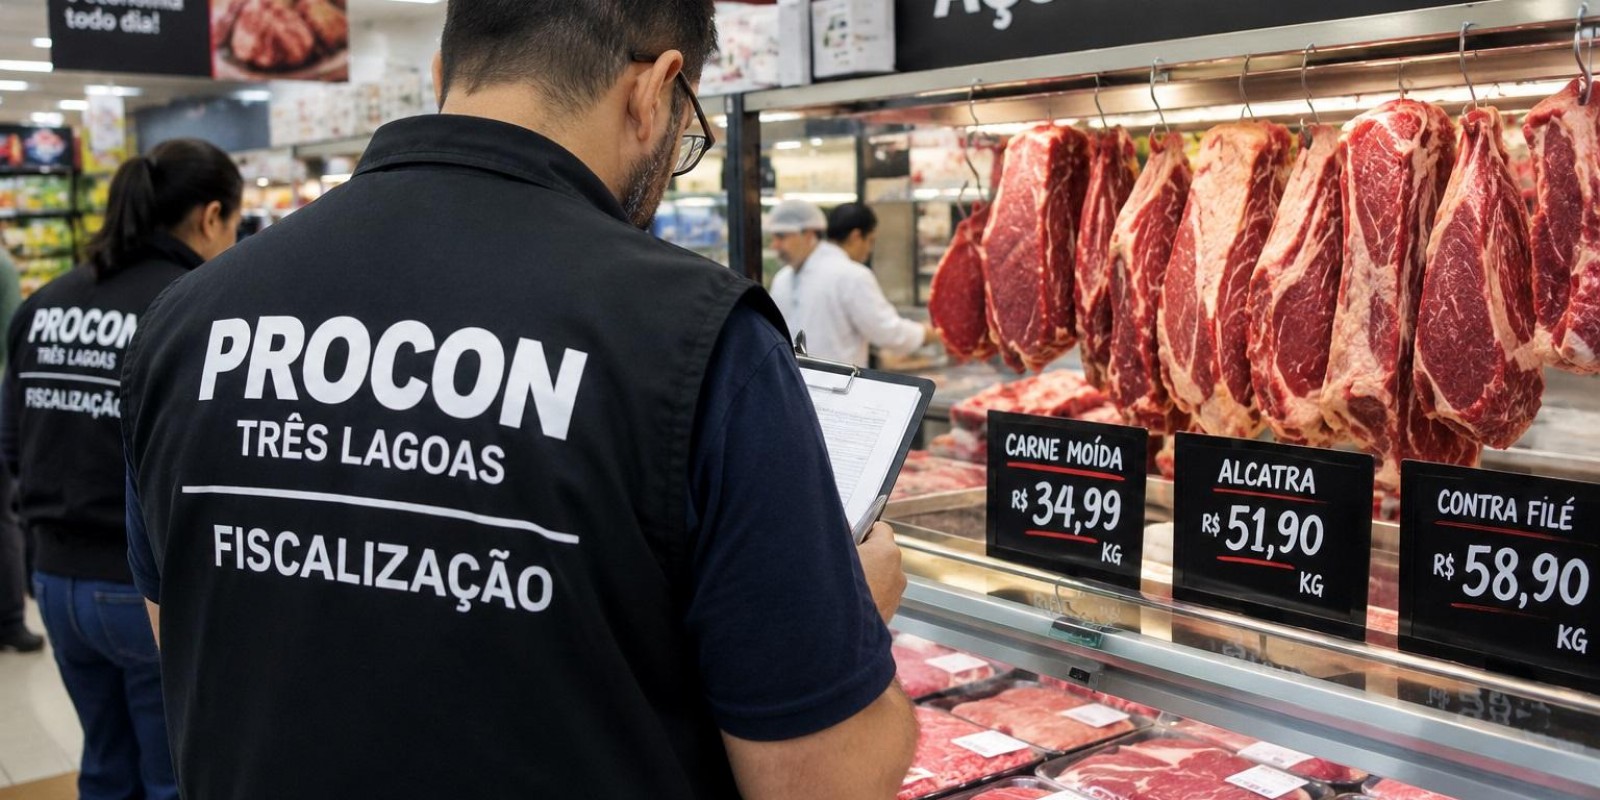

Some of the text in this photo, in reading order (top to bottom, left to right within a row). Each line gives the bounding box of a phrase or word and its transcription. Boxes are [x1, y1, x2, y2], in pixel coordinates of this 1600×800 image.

[65, 7, 160, 34] todo dia!
[37, 344, 117, 370] TRÊS LAGOAS
[199, 315, 588, 442] PROCON
[236, 412, 506, 485] TRÊS LAGOAS
[1005, 433, 1123, 472] CARNE MOÍDA
[1217, 458, 1316, 496] ALCATRA
[1011, 481, 1121, 536] R$ 34,99
[1437, 488, 1518, 524] CONTRA
[1201, 504, 1324, 561] R$ 51,90
[213, 524, 554, 613] FISCALIZAÇÃO
[1101, 541, 1123, 566] KG
[1299, 570, 1324, 598] KG
[1433, 544, 1590, 610] R$ 58,90
[1557, 624, 1588, 655] KG
